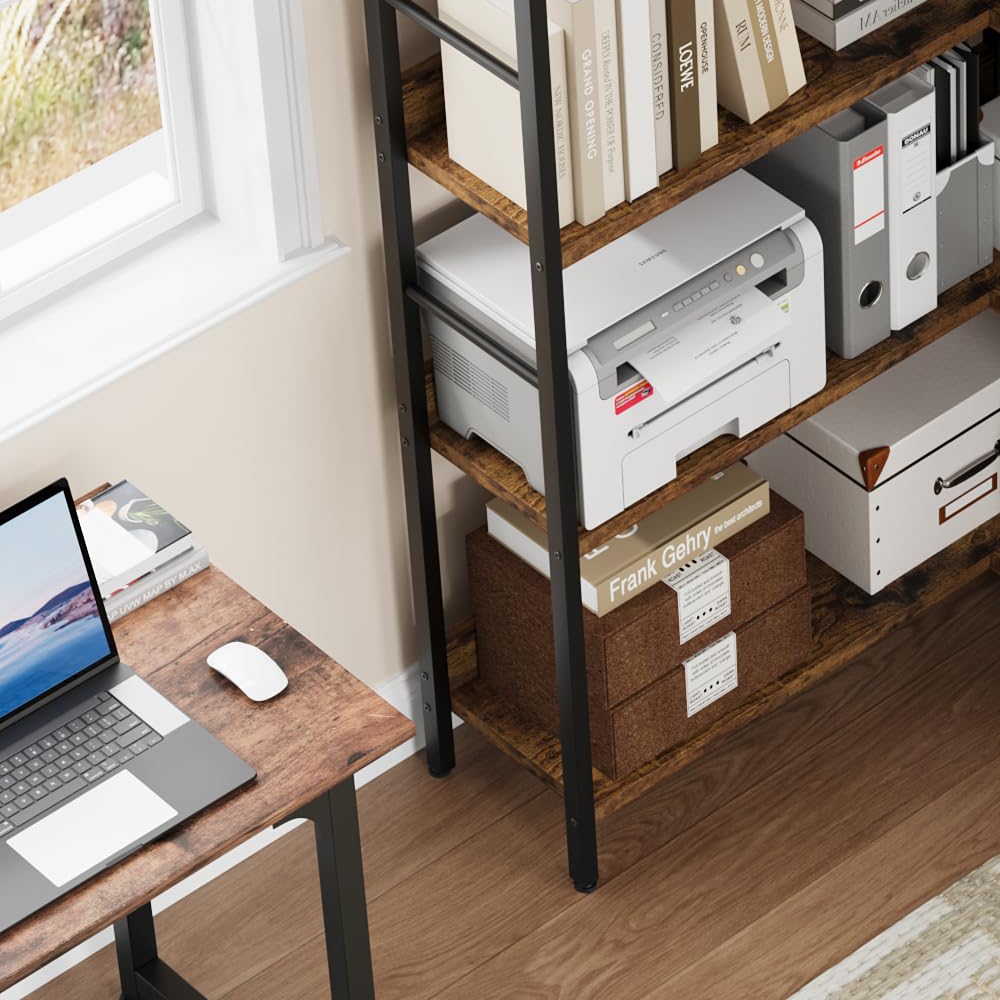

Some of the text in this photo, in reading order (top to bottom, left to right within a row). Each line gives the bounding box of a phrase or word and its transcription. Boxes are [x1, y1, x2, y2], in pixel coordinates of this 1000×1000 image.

[735, 18, 752, 52] RUM
[757, 3, 770, 37] MODERN
[678, 40, 694, 94] LOEWE
[700, 20, 709, 75] OPENHOUSE
[763, 34, 775, 63] DESIGN
[651, 31, 666, 121] CONSIDERED
[581, 48, 598, 160] GRAND OPENING
[904, 126, 930, 145] DONAU
[608, 559, 657, 603] Frank
[661, 523, 713, 570] Gehry
[713, 522, 723, 534] the
[722, 514, 738, 532] best
[738, 499, 764, 524] architects
[119, 598, 142, 615] UVW
[142, 584, 164, 602] MAP
[164, 575, 177, 589] BY
